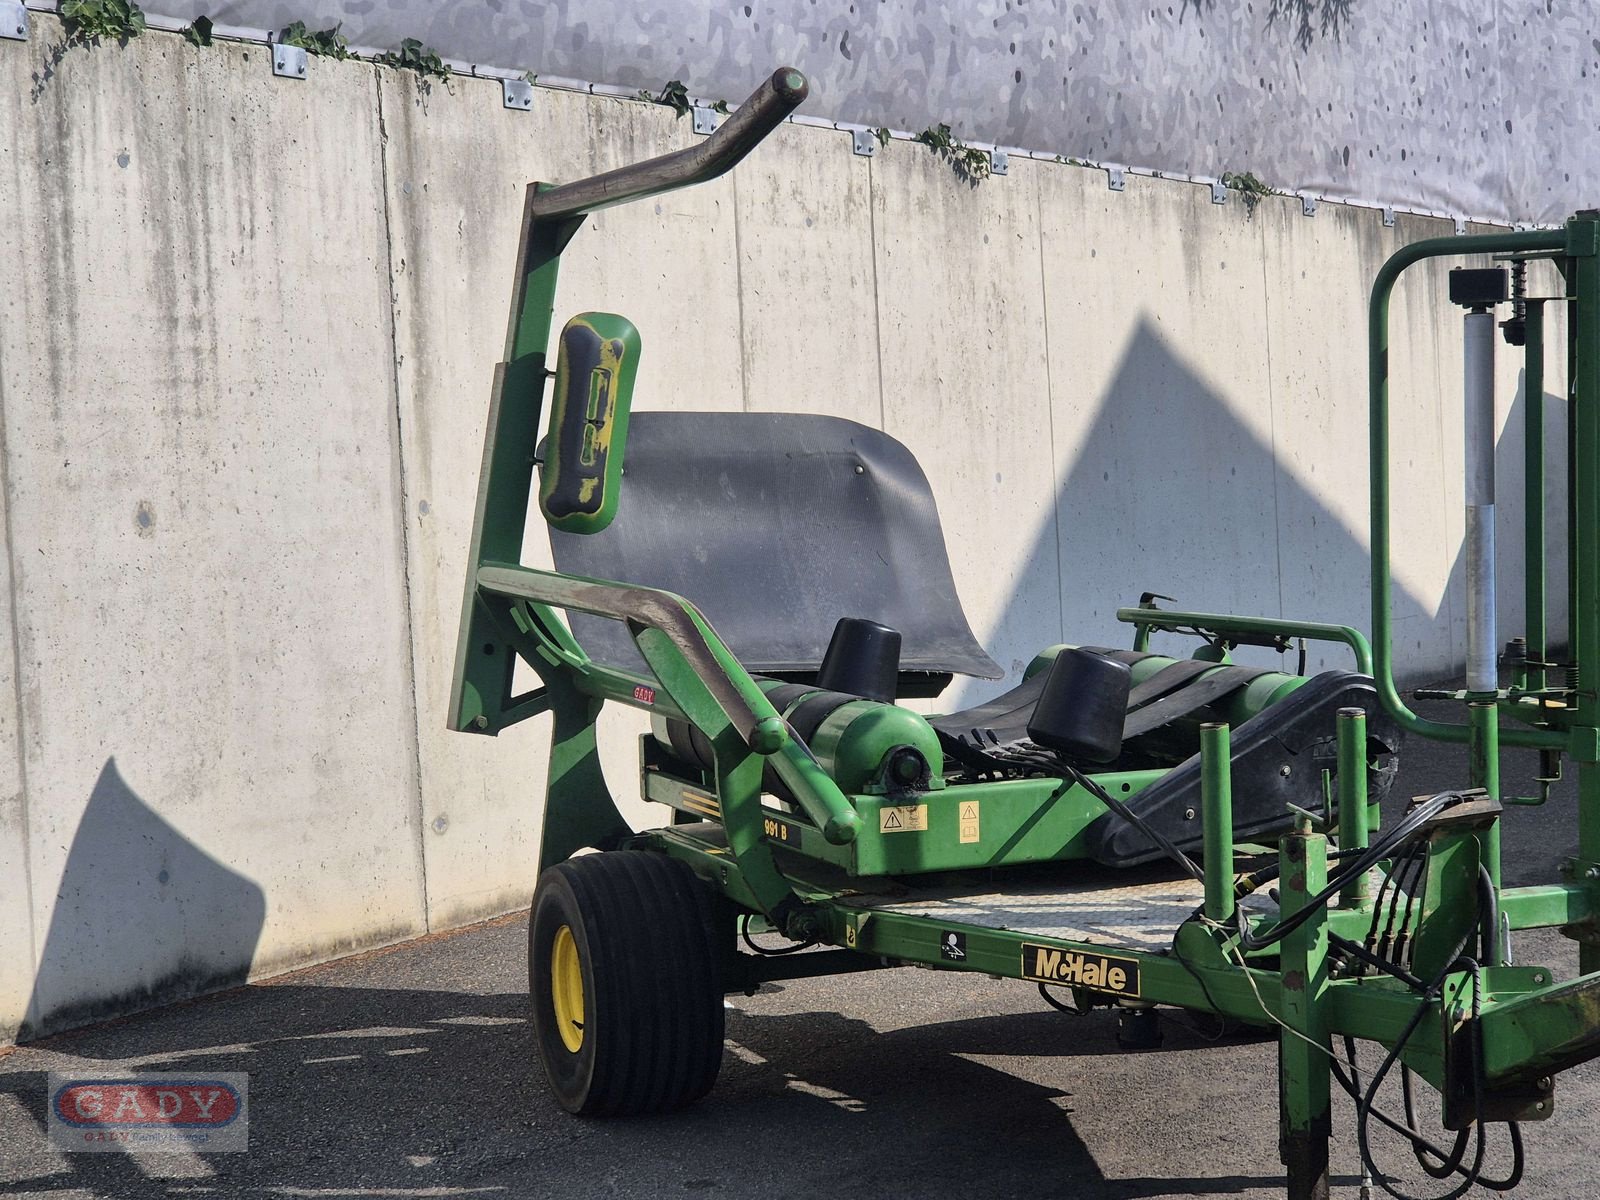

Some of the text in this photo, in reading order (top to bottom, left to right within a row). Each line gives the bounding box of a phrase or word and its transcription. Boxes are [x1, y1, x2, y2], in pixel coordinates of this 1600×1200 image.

[634, 687, 653, 702] GADY
[764, 819, 787, 840] 991 B
[1035, 948, 1126, 990] McHale
